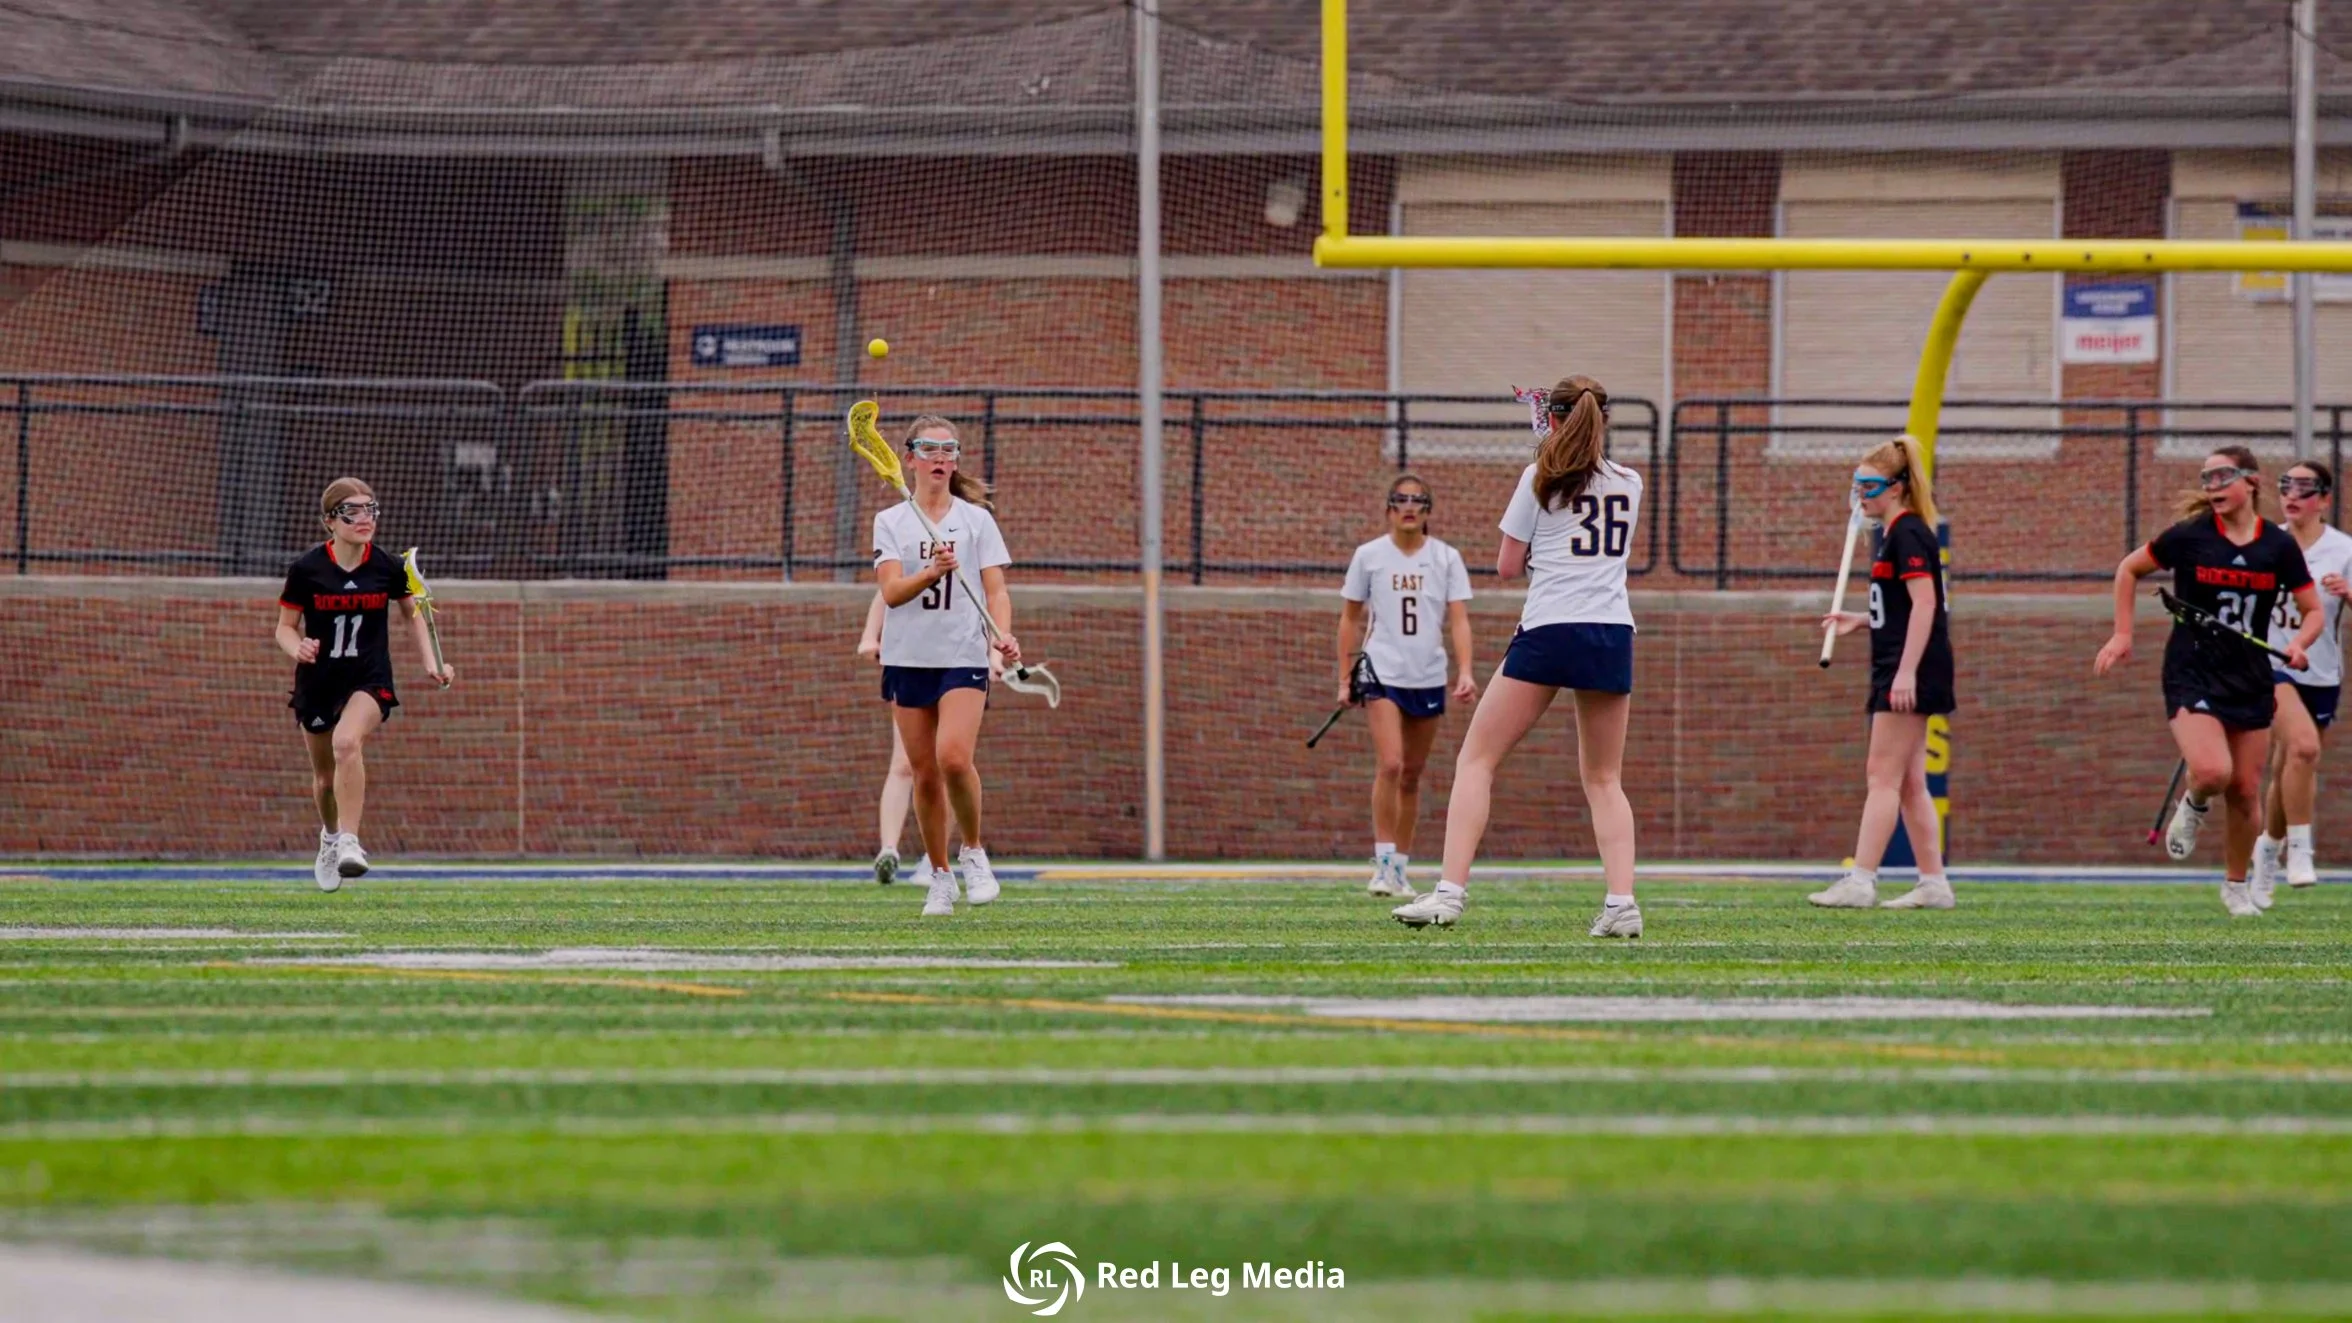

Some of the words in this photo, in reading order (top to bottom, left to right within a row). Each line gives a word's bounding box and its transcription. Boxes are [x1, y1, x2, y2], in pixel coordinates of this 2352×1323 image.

[1571, 494, 1630, 557] 36
[1393, 574, 1424, 591] EAST
[1402, 596, 1417, 636] 6
[2217, 591, 2257, 636] 21
[330, 614, 363, 658] 11
